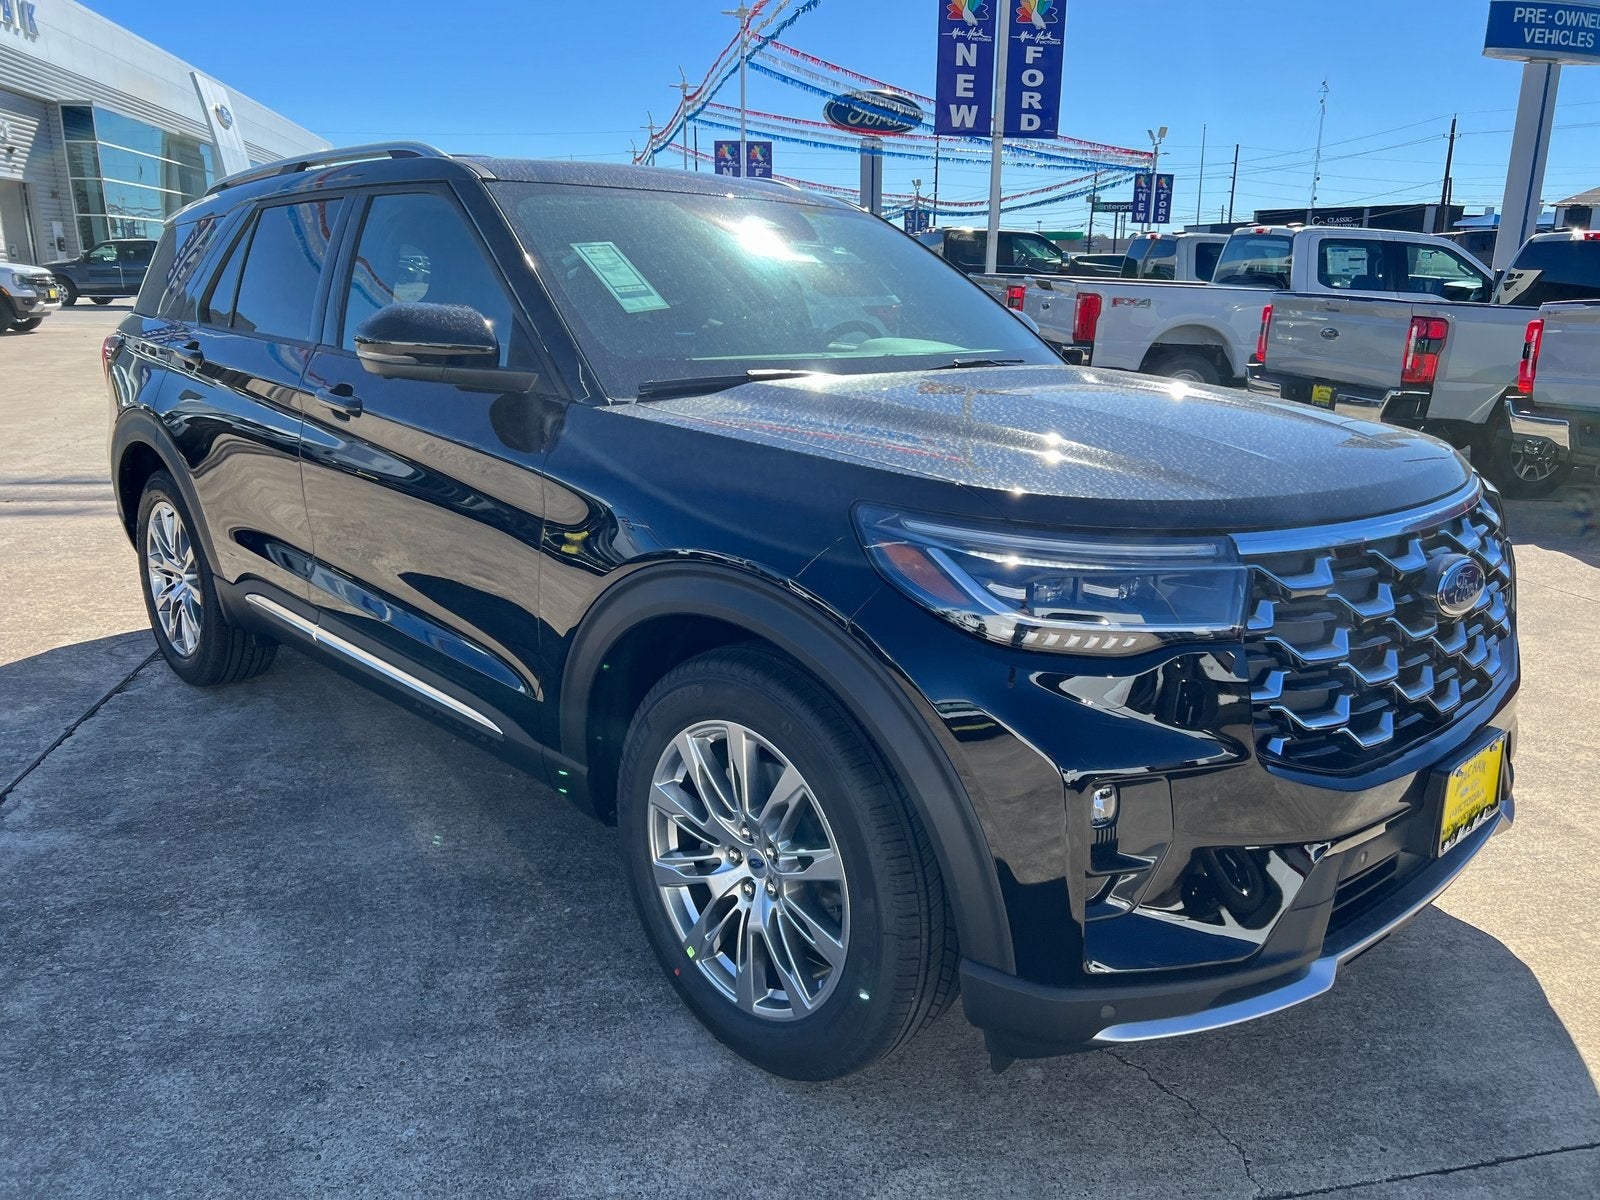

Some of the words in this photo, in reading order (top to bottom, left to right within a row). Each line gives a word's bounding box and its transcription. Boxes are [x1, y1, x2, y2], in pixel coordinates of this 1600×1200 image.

[1524, 28, 1595, 48] VEHICLES
[949, 43, 979, 129] NEW
[1020, 46, 1044, 131] FORD
[1136, 193, 1145, 221] NEW
[1158, 194, 1167, 222] FORD
[1111, 297, 1152, 308] FX4
